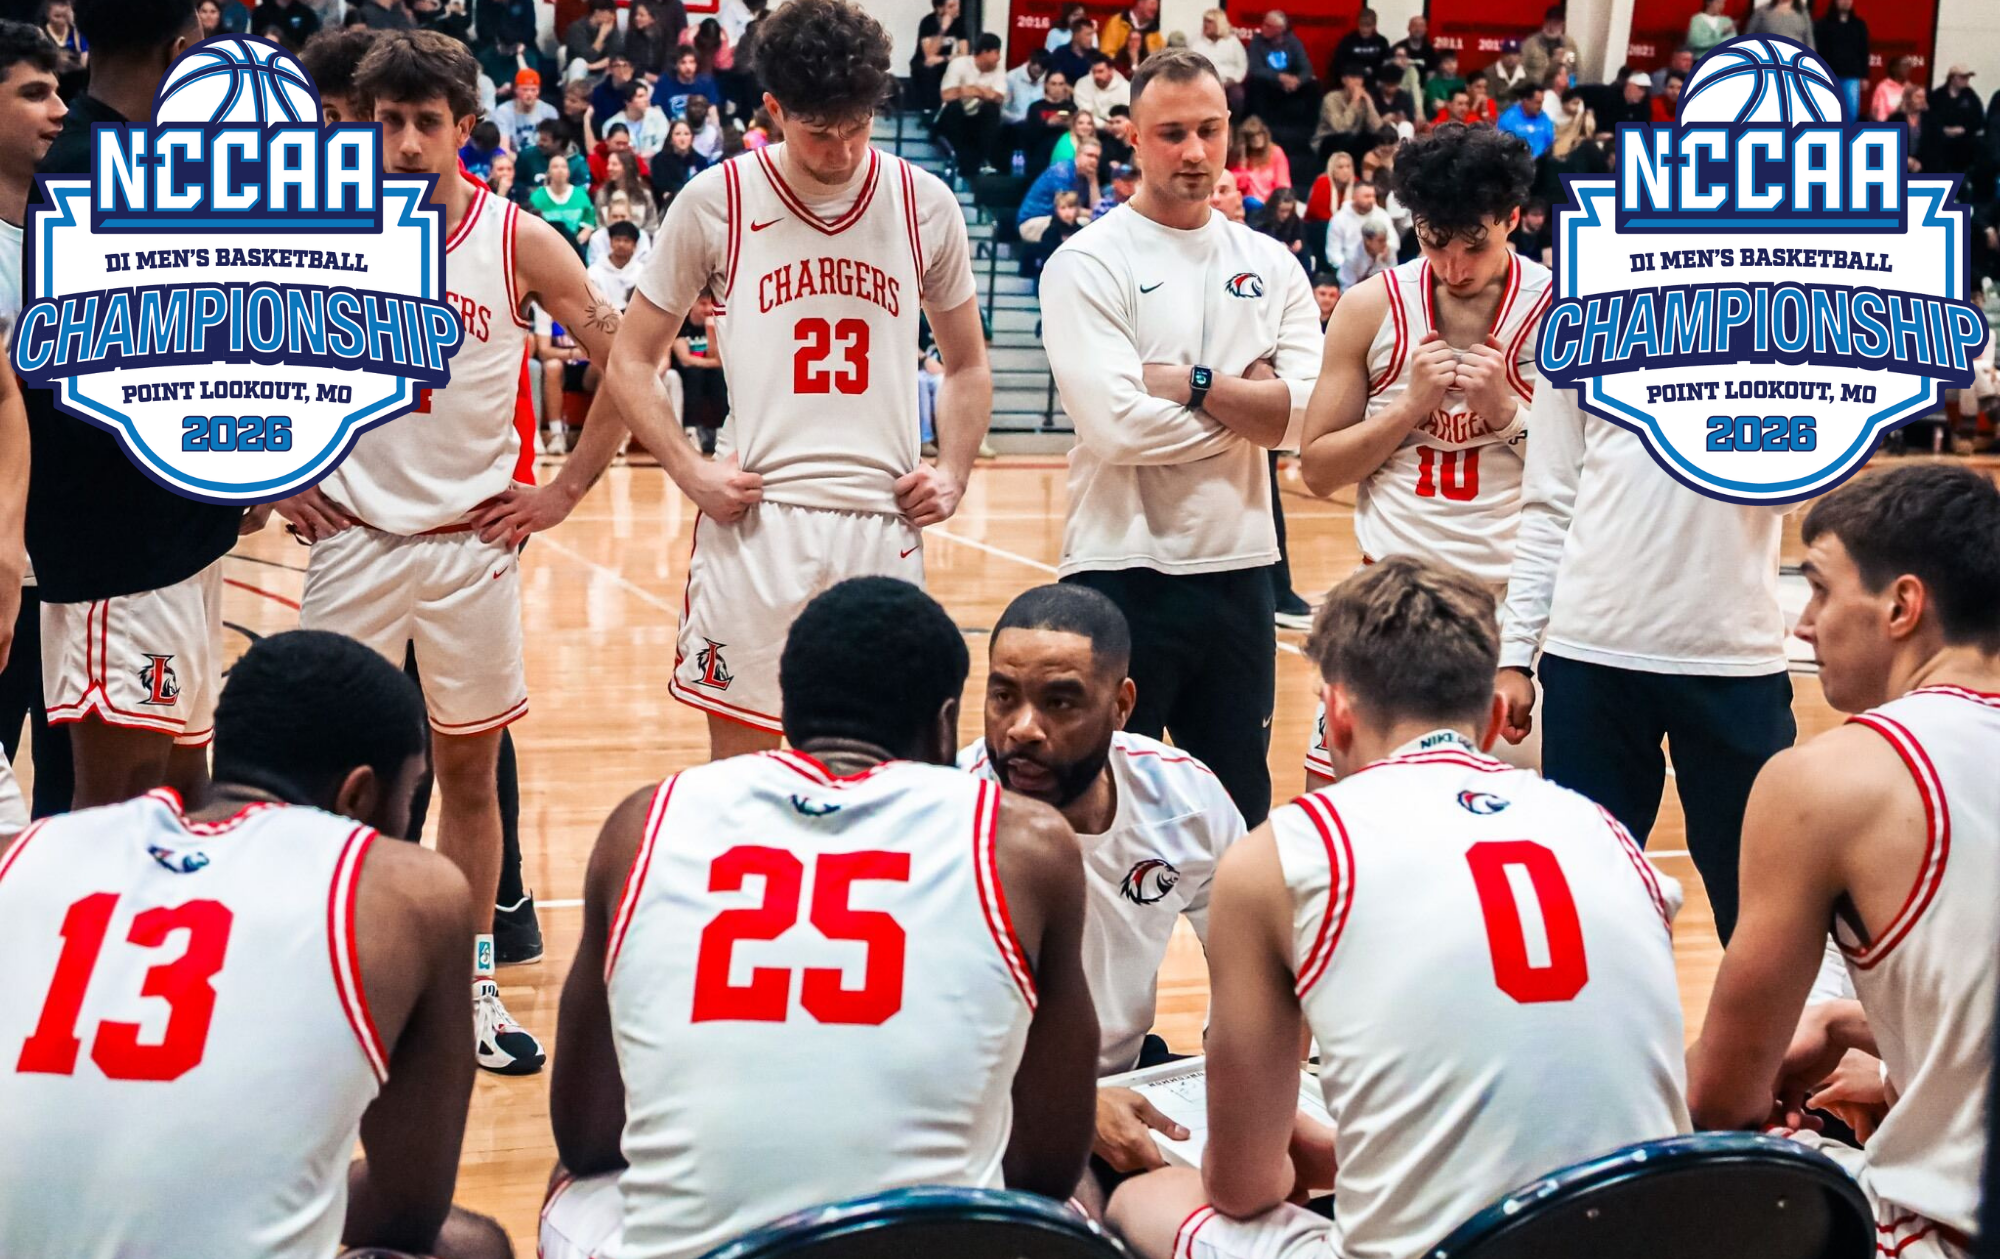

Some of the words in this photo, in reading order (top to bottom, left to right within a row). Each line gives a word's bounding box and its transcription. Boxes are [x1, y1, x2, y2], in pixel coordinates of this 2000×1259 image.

[1478, 38, 1504, 51] 201
[759, 257, 900, 318] CHARGERS
[793, 317, 870, 395] 23
[1414, 445, 1480, 502] 10
[690, 845, 911, 1027] 25
[1464, 839, 1590, 1005] 0
[15, 891, 234, 1083] 13
